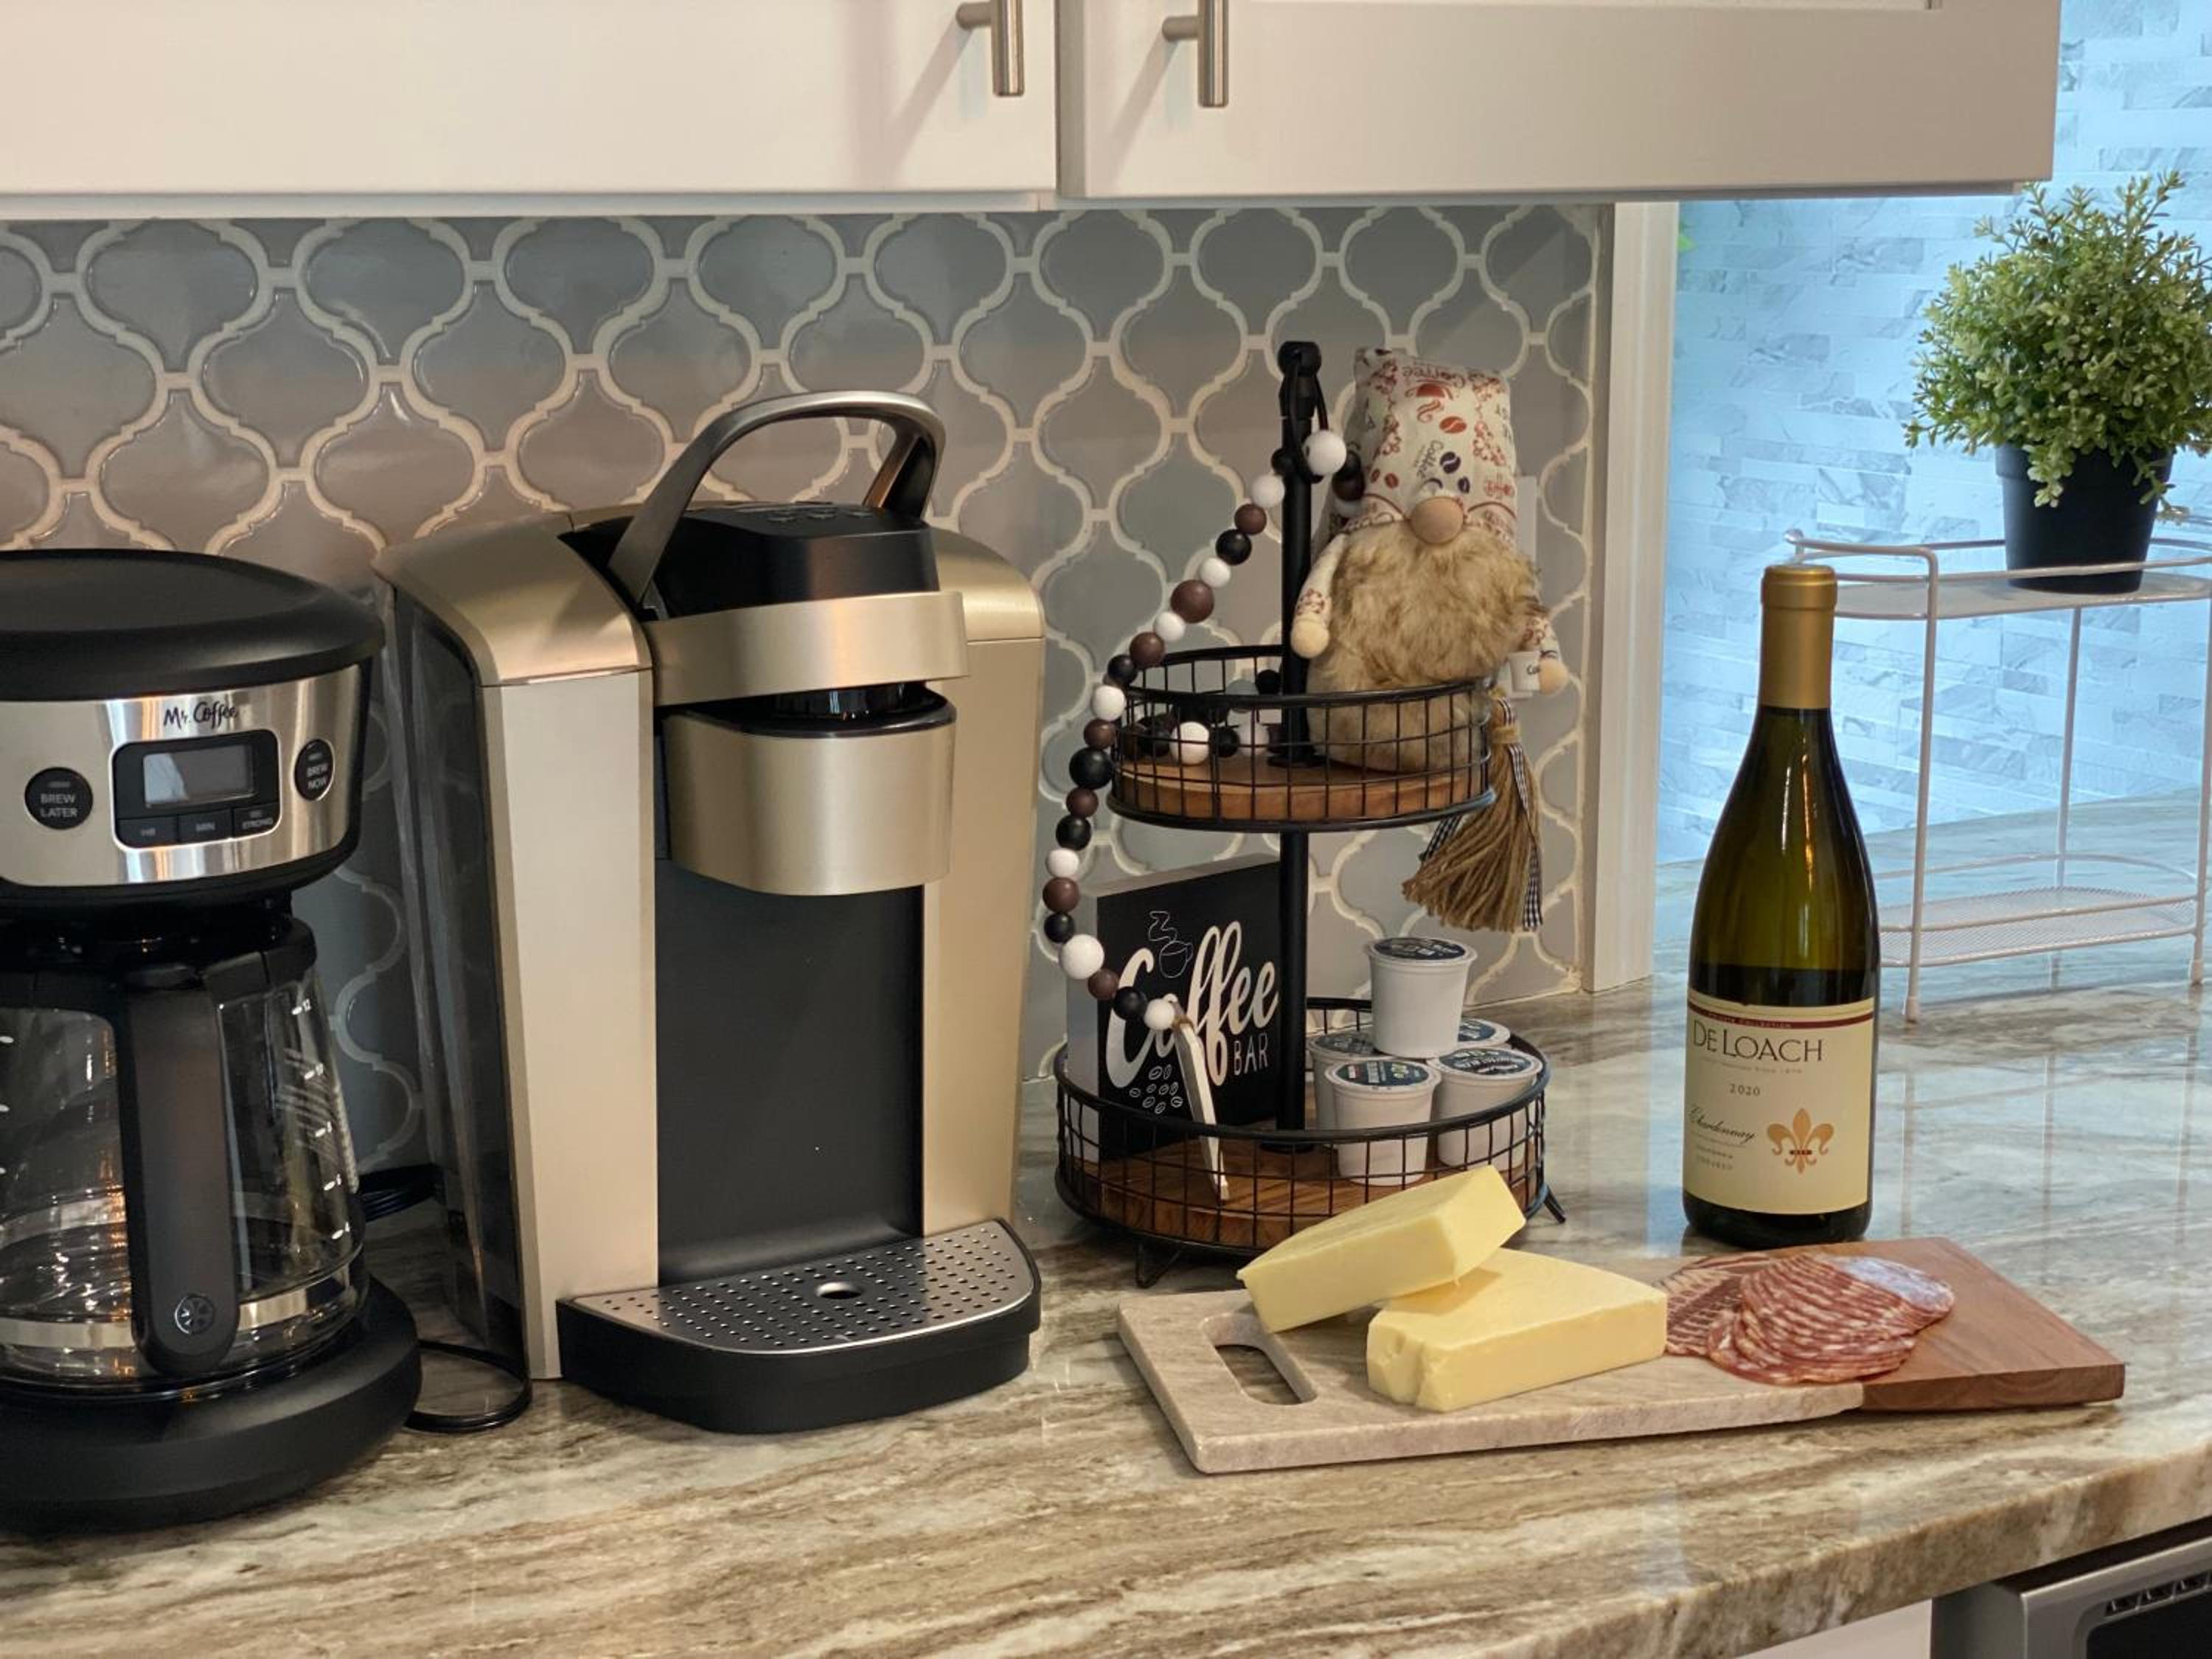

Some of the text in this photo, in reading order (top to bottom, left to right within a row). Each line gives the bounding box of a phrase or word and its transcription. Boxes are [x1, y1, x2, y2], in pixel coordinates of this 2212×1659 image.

[193, 700, 238, 729] Coffee
[307, 763, 329, 778] BREW
[307, 776, 328, 789] NOW
[41, 793, 76, 804] BREW
[41, 807, 78, 818] LATER
[1233, 1033, 1269, 1075] BAR
[1730, 1082, 1761, 1096] 2020
